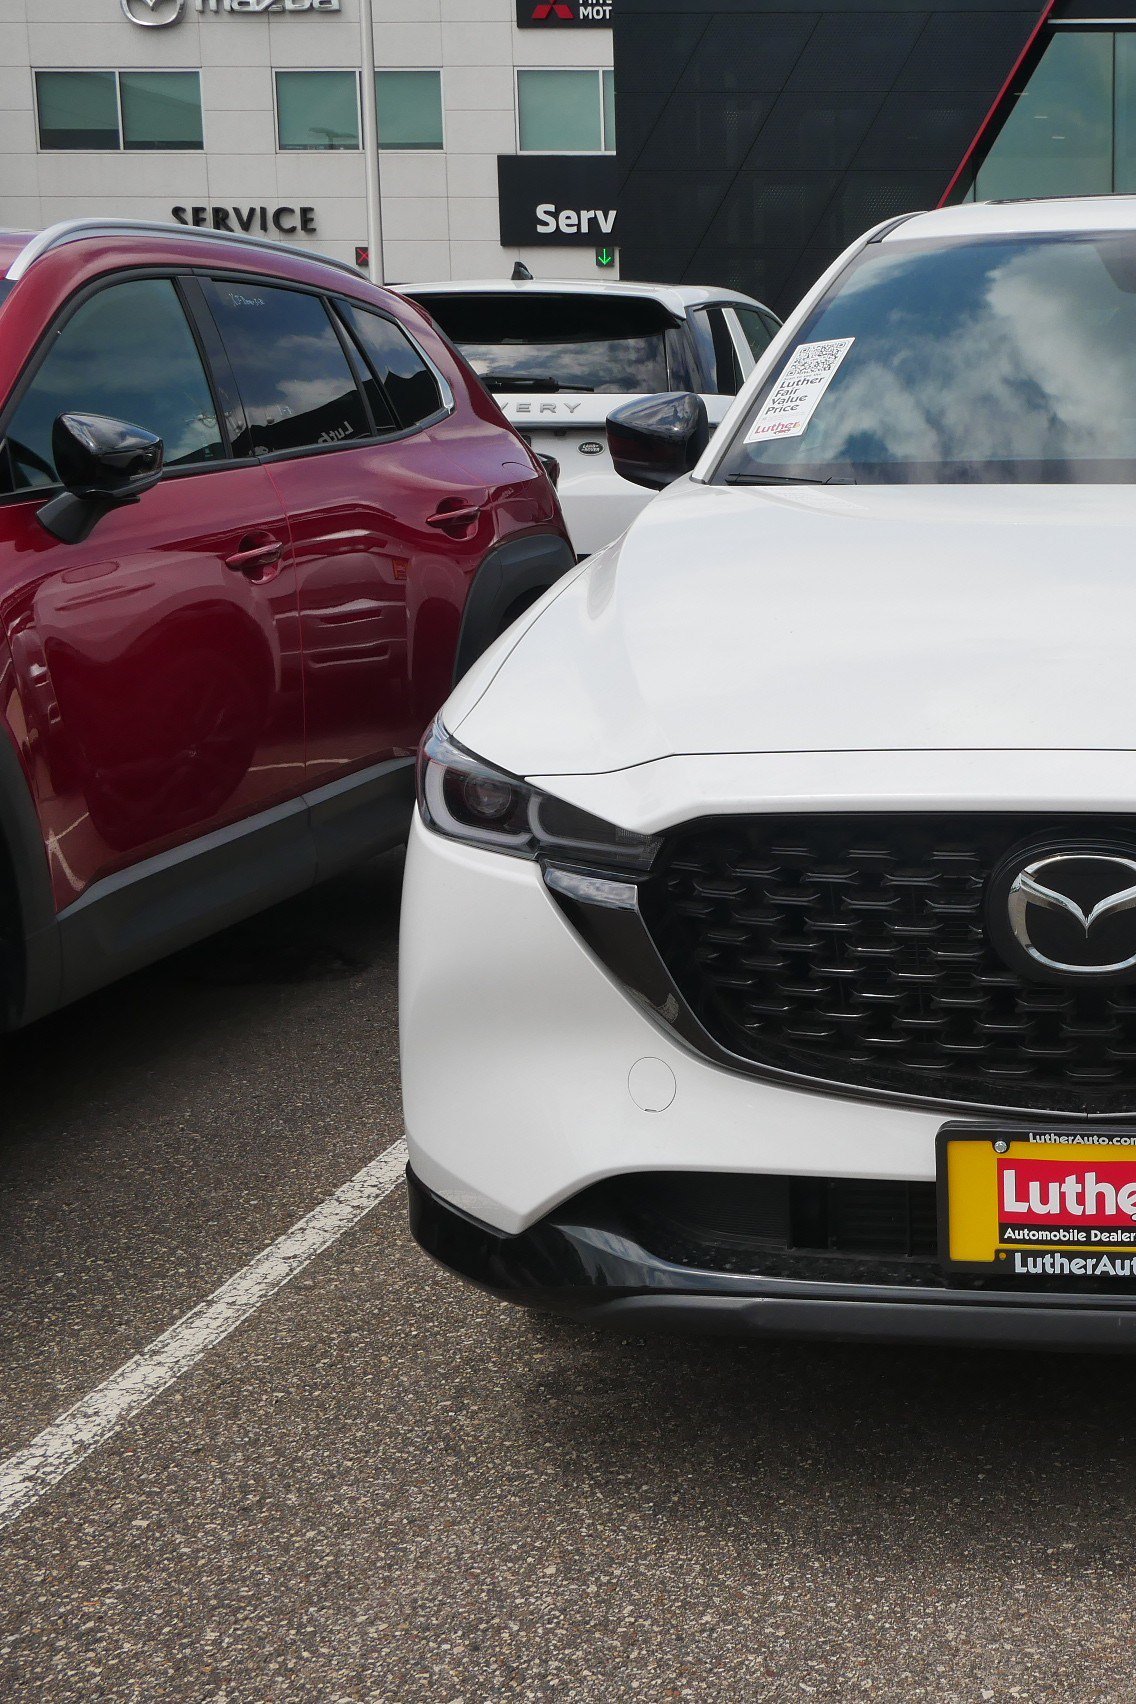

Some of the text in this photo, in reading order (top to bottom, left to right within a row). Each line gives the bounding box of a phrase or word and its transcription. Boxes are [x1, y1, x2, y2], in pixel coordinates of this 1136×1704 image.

[579, 6, 613, 19] MOT
[171, 206, 317, 233] SERVICE
[536, 203, 617, 234] Serv
[780, 376, 825, 389] Luther
[775, 388, 800, 398] Fair
[771, 395, 809, 406] Value
[765, 404, 800, 416] Price
[754, 421, 801, 435] Luther
[1003, 1228, 1087, 1242] Automobile
